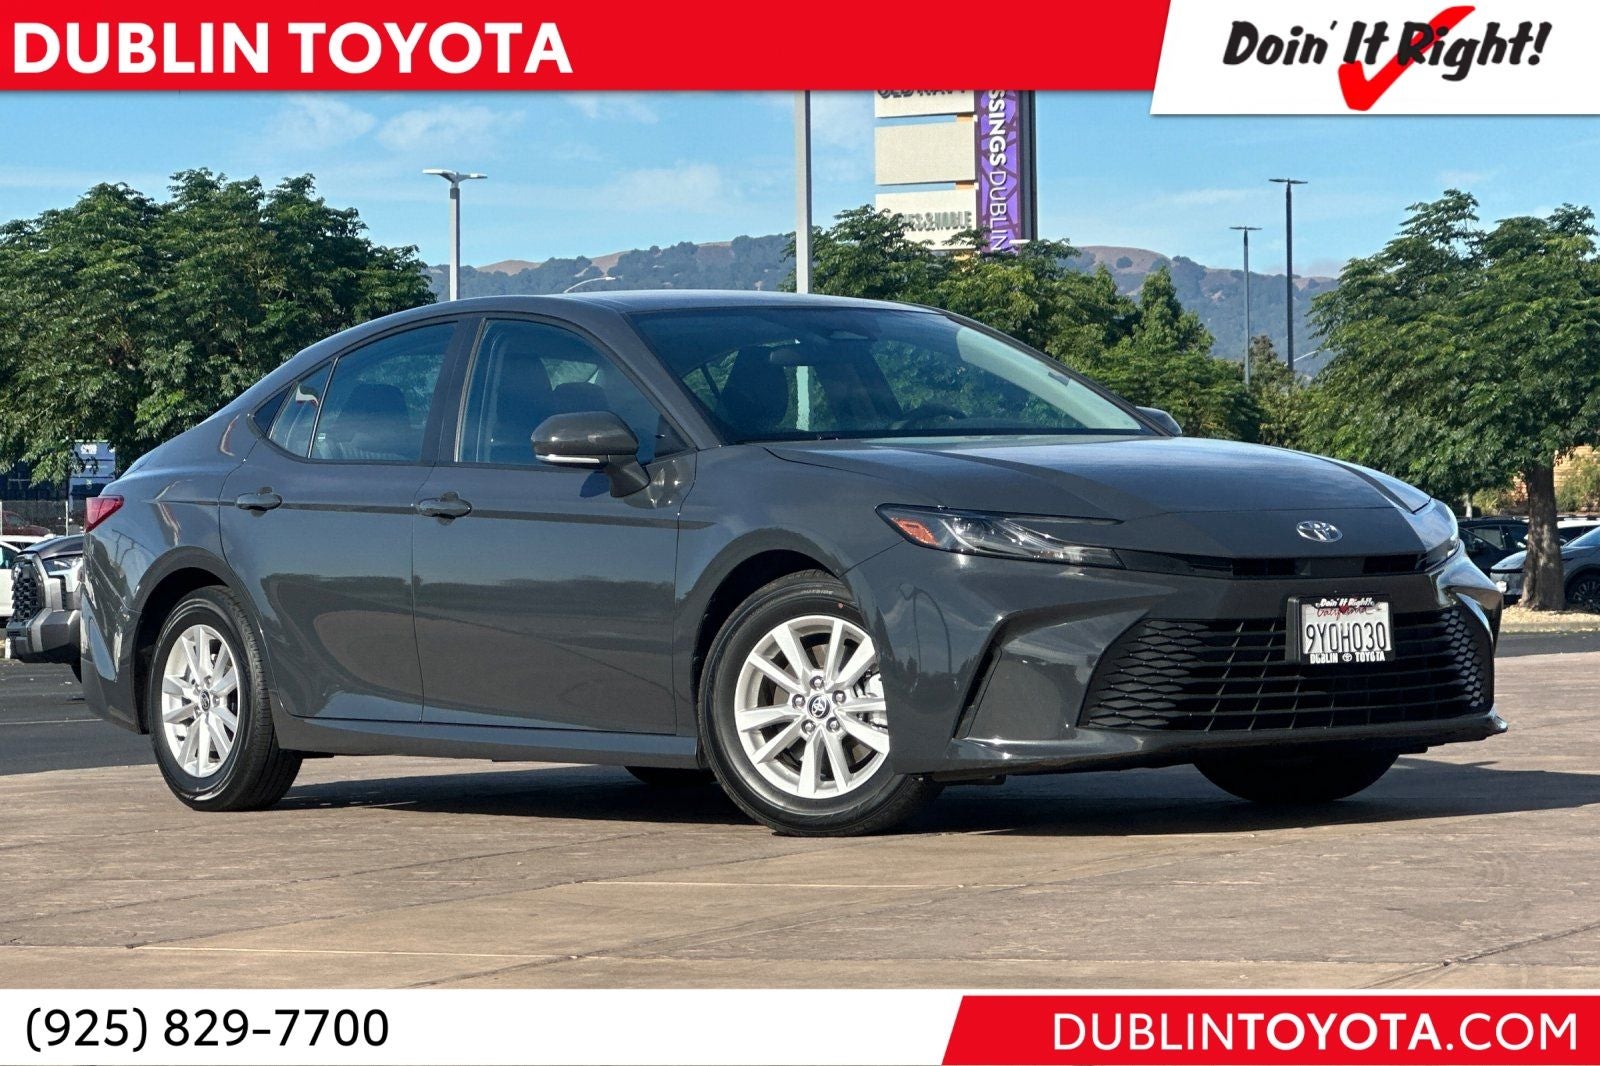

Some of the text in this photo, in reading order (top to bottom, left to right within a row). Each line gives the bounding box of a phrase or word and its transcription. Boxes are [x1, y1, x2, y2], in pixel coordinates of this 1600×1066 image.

[989, 170, 1009, 251] DUBLIN
[1309, 651, 1386, 664] DUBLIN TOYOTA
